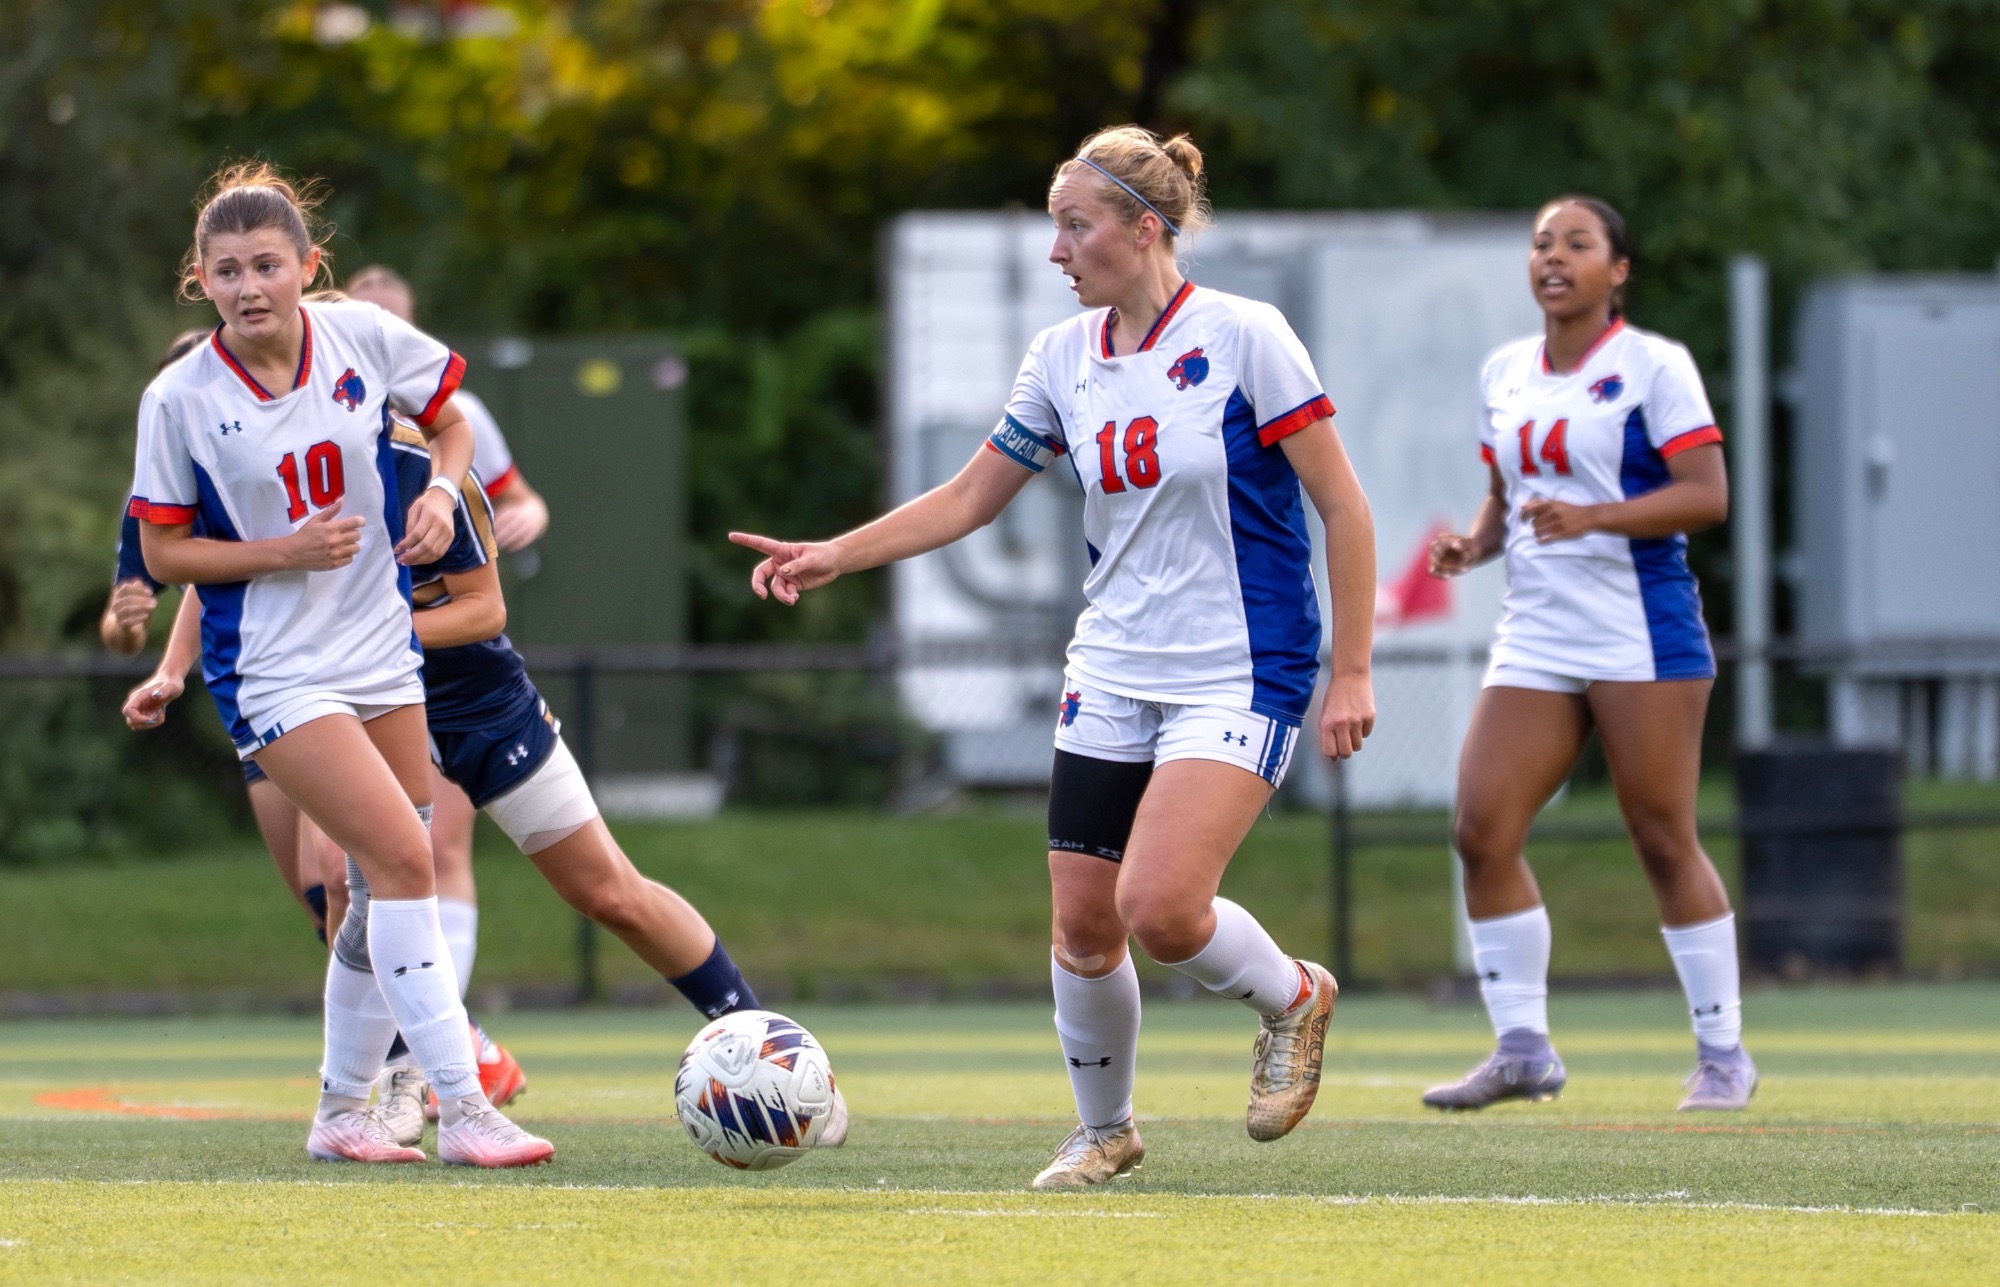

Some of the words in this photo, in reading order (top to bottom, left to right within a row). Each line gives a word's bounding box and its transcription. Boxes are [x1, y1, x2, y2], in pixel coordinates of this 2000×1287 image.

[997, 421, 1041, 461] CAPTAIN
[1096, 415, 1162, 495] 18
[1518, 418, 1573, 478] 14
[276, 440, 345, 524] 10
